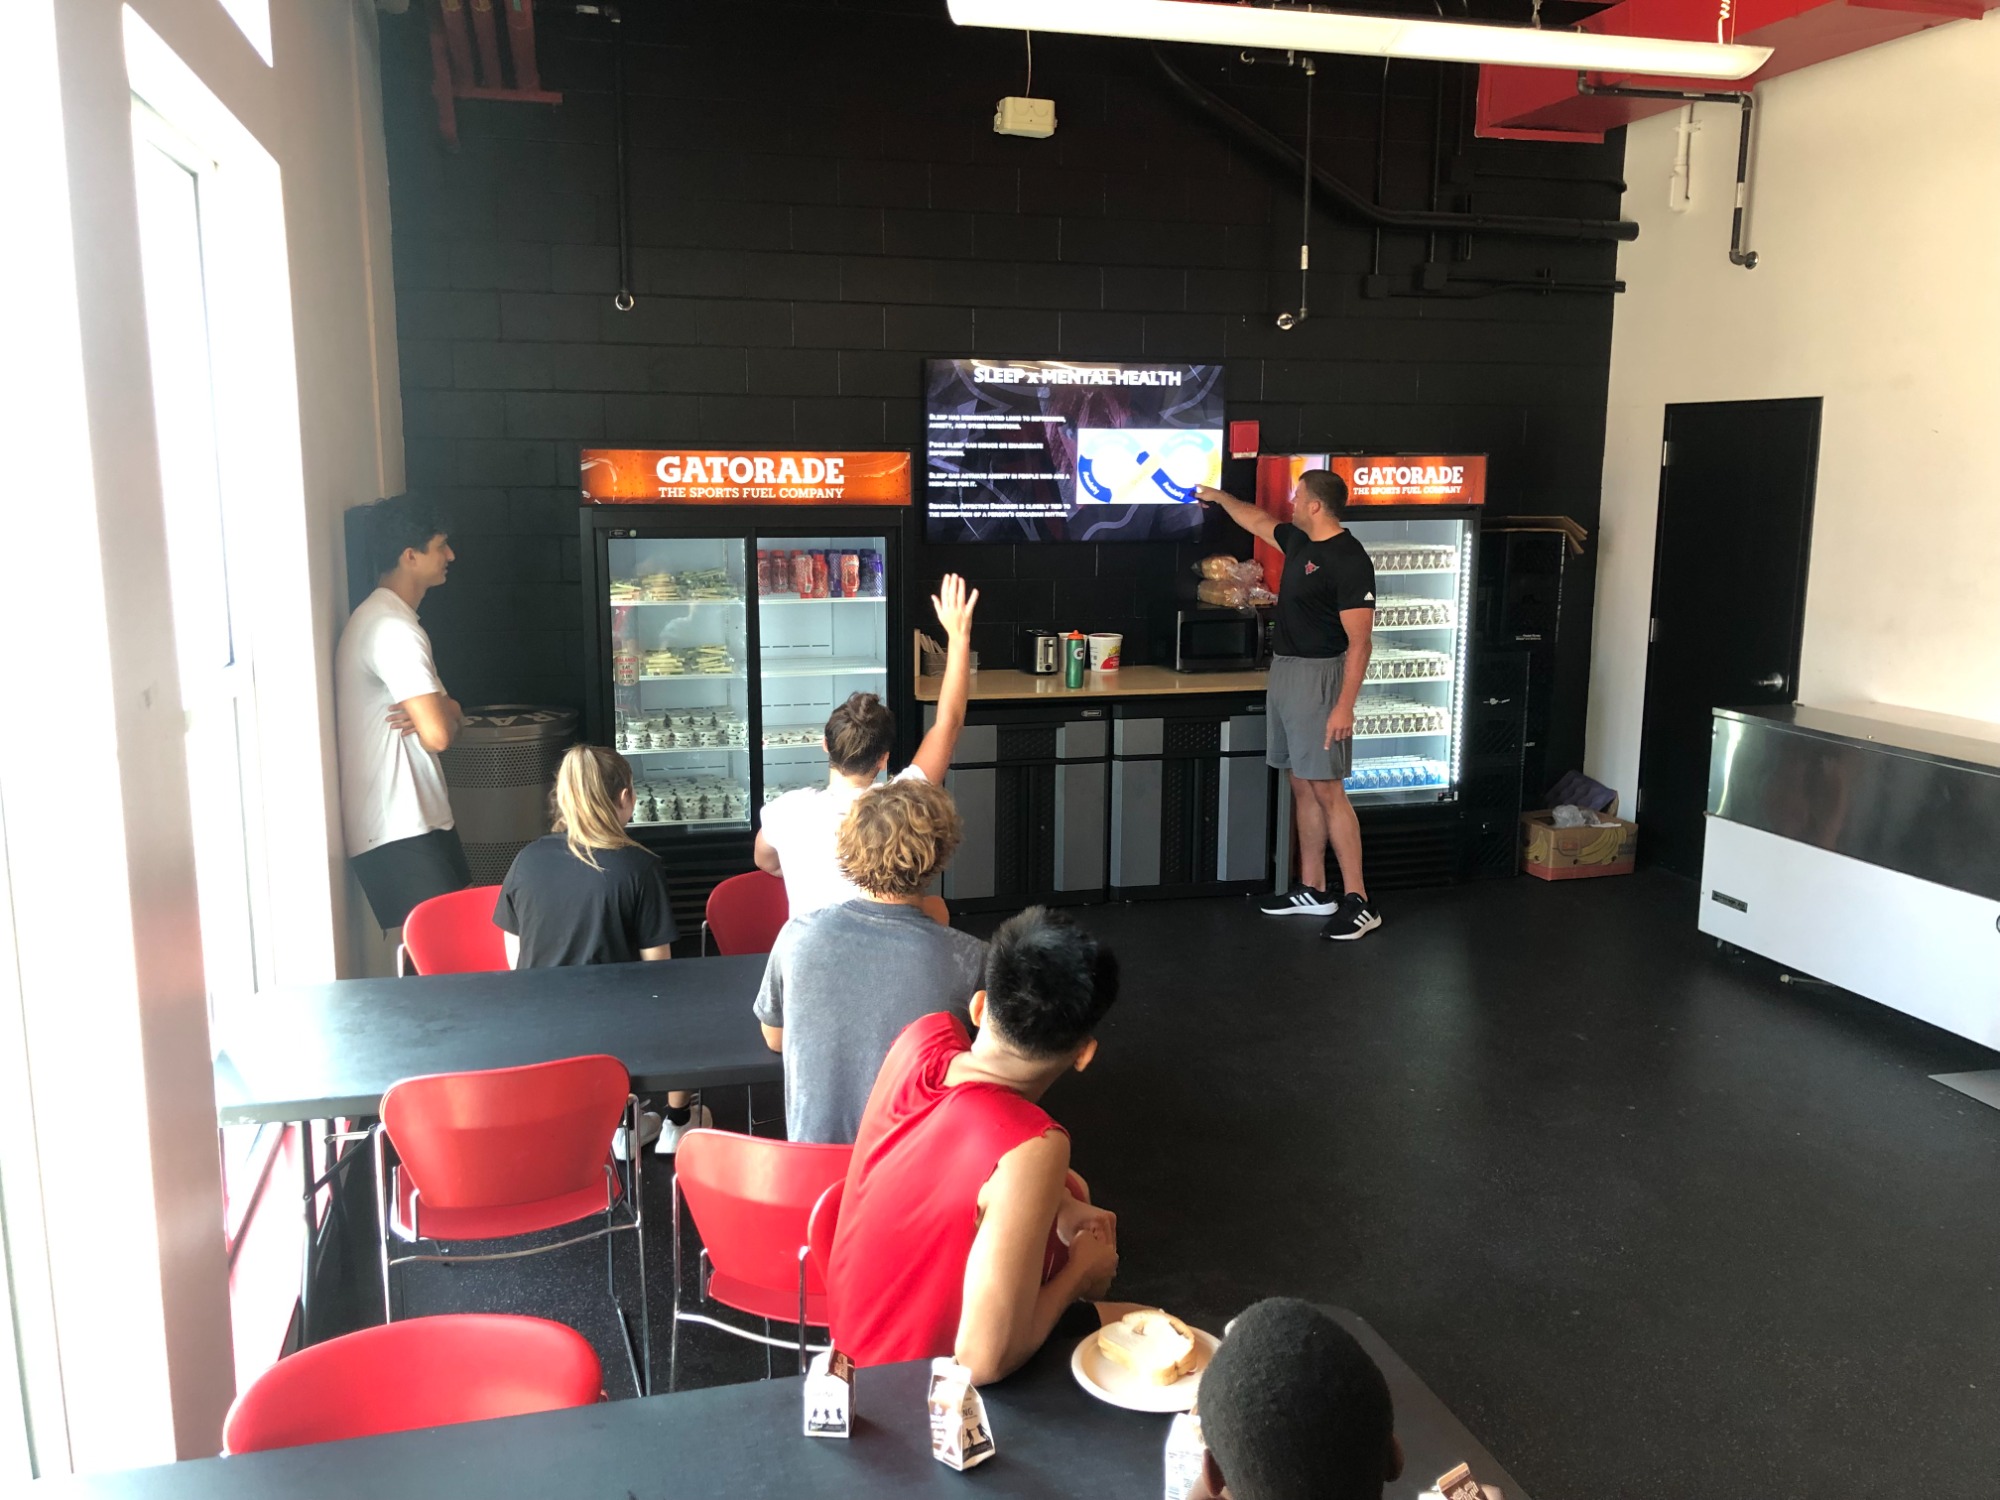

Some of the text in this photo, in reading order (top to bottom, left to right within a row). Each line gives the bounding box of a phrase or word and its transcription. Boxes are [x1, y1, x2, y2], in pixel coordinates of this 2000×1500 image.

[974, 367, 1025, 384] SLEEP
[1041, 369, 1112, 385] MENTAL
[1115, 371, 1182, 387] HEALTH
[656, 456, 845, 485] GATORADE
[1353, 466, 1464, 486] GATORADE
[658, 487, 845, 499] THE SPORTS FUEL COMPANY
[1353, 486, 1462, 495] THE SPORTS FUEL COMPANY
